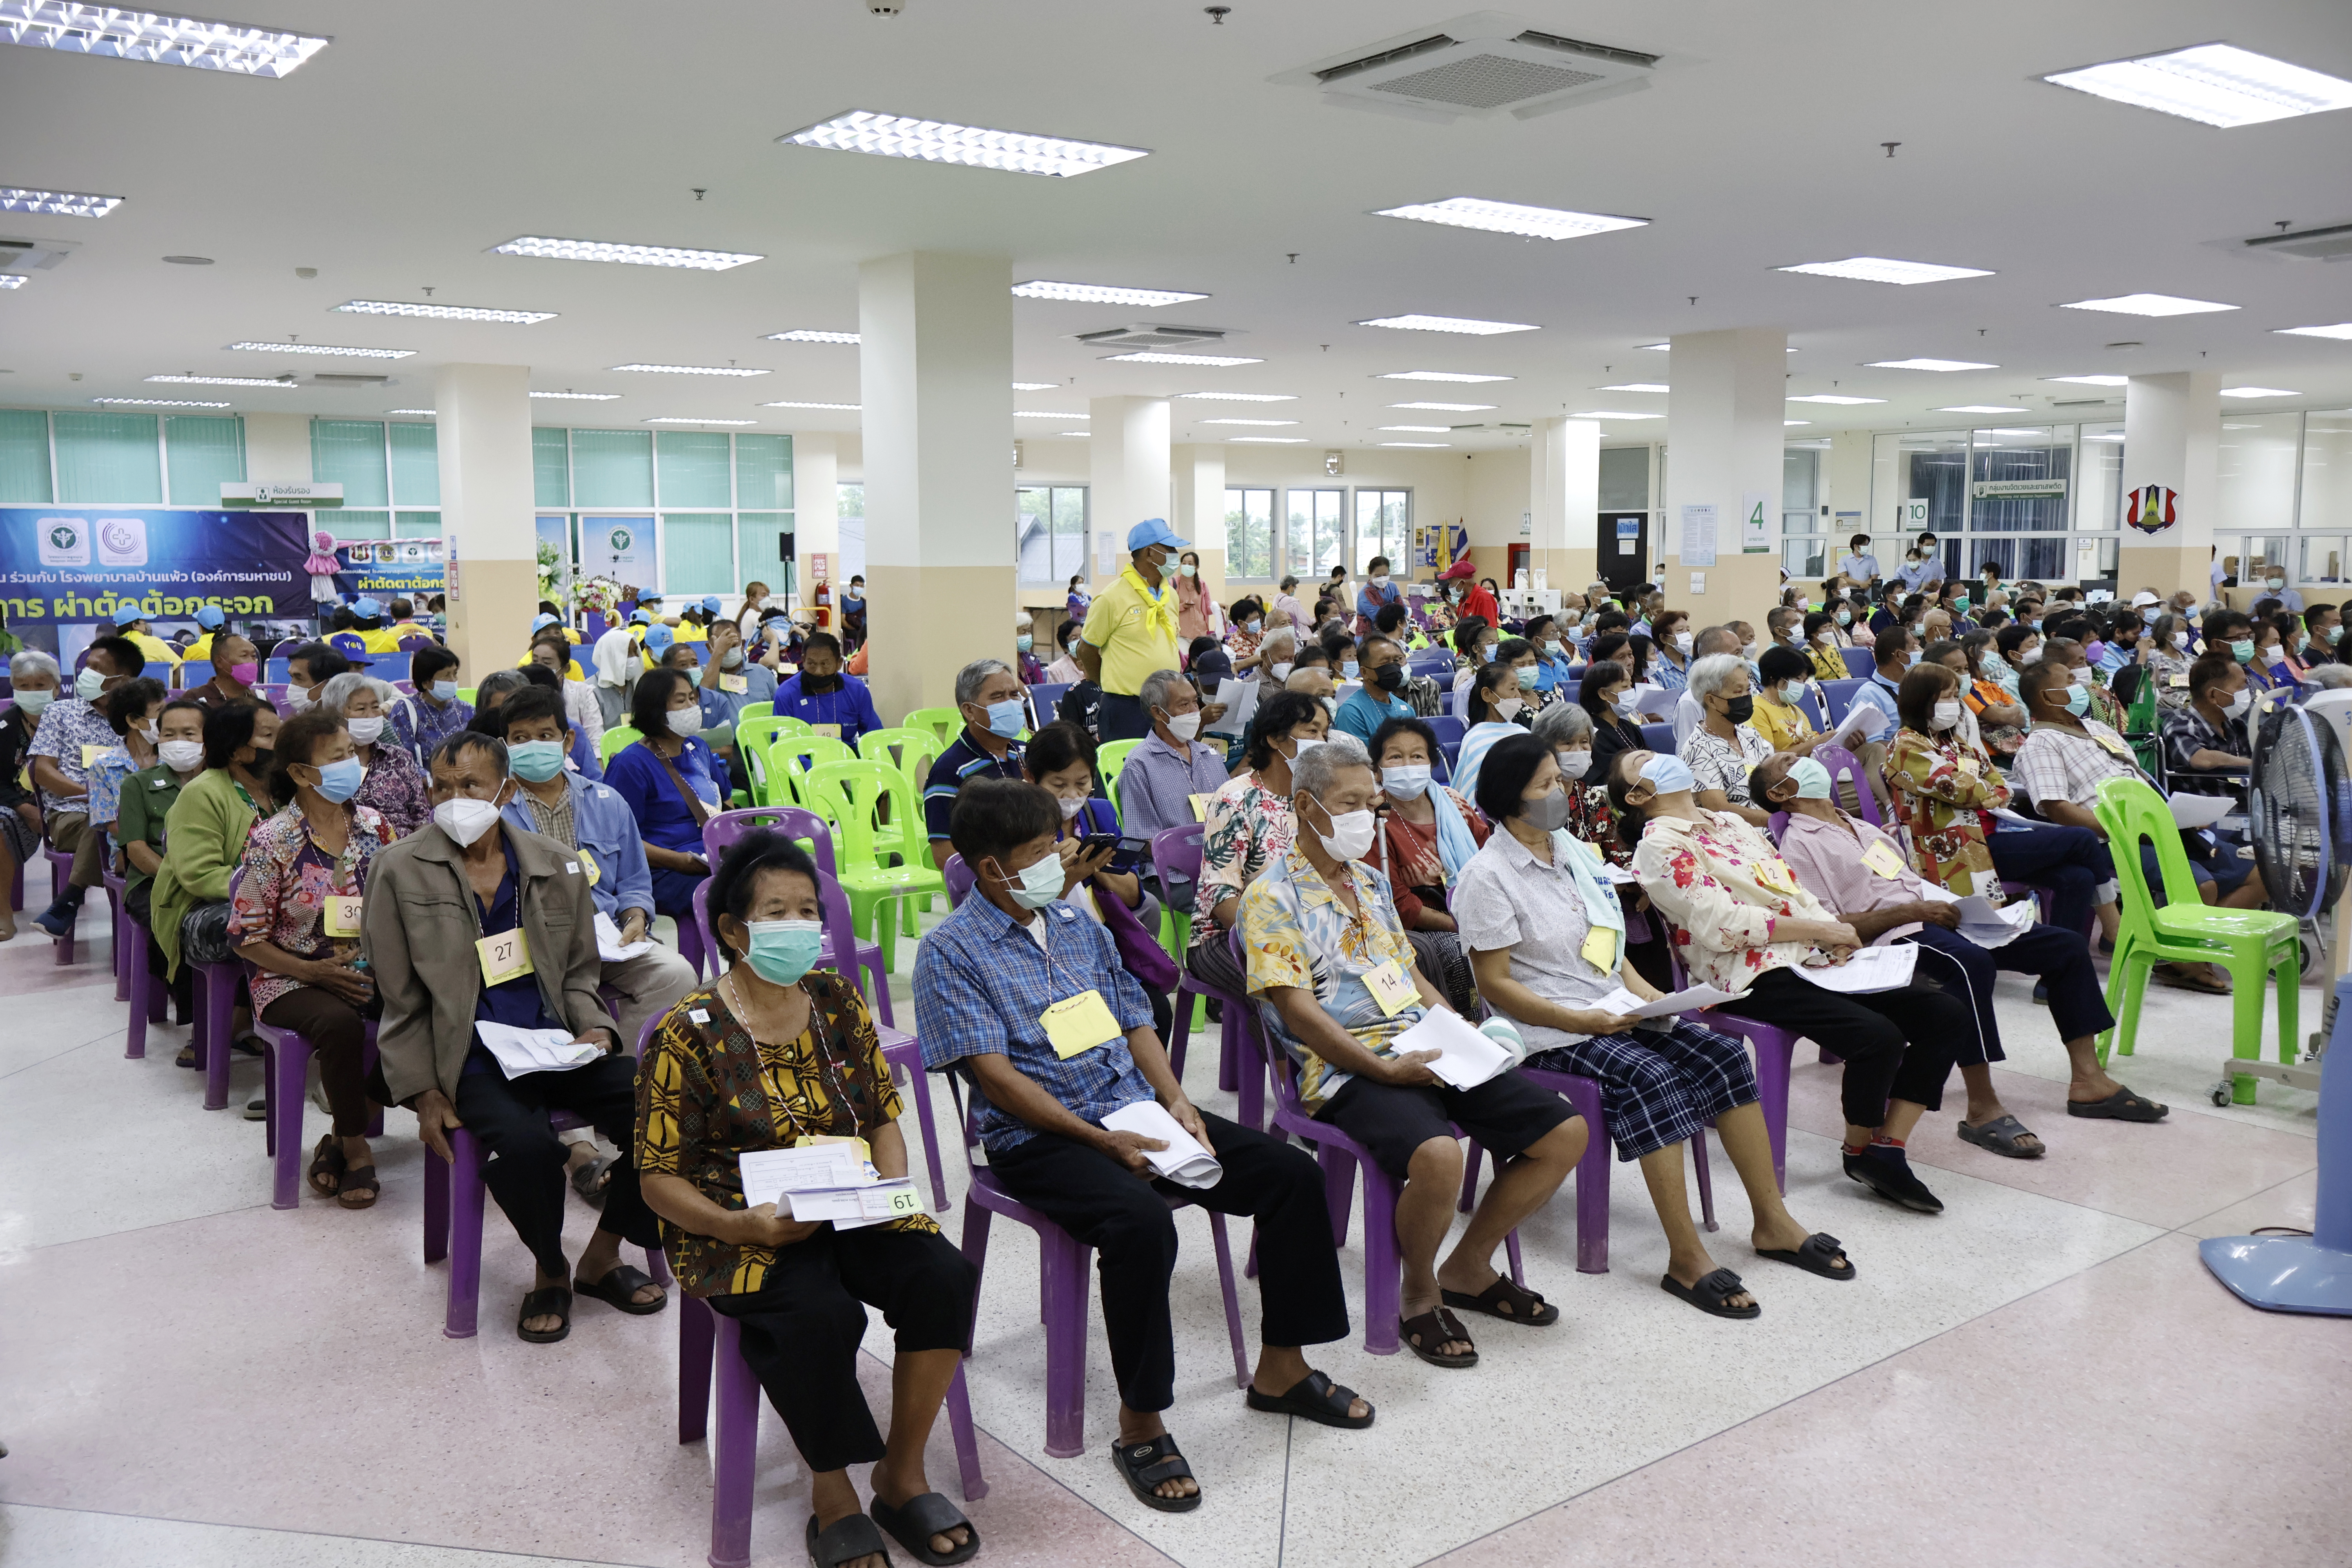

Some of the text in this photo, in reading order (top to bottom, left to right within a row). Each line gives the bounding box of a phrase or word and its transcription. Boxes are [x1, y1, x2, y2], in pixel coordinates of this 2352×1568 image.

[1750, 501, 1764, 530] 4
[1909, 505, 1926, 519] 10
[10, 570, 56, 583] ร่วมกับ
[59, 570, 189, 583] โรงพยาบาลบ้านแพ้ว
[191, 570, 292, 583] (องค์การมหาชน)
[1769, 868, 1778, 878] 2
[495, 941, 512, 962] 27
[1382, 973, 1397, 991] 14
[894, 1194, 914, 1209] 19
